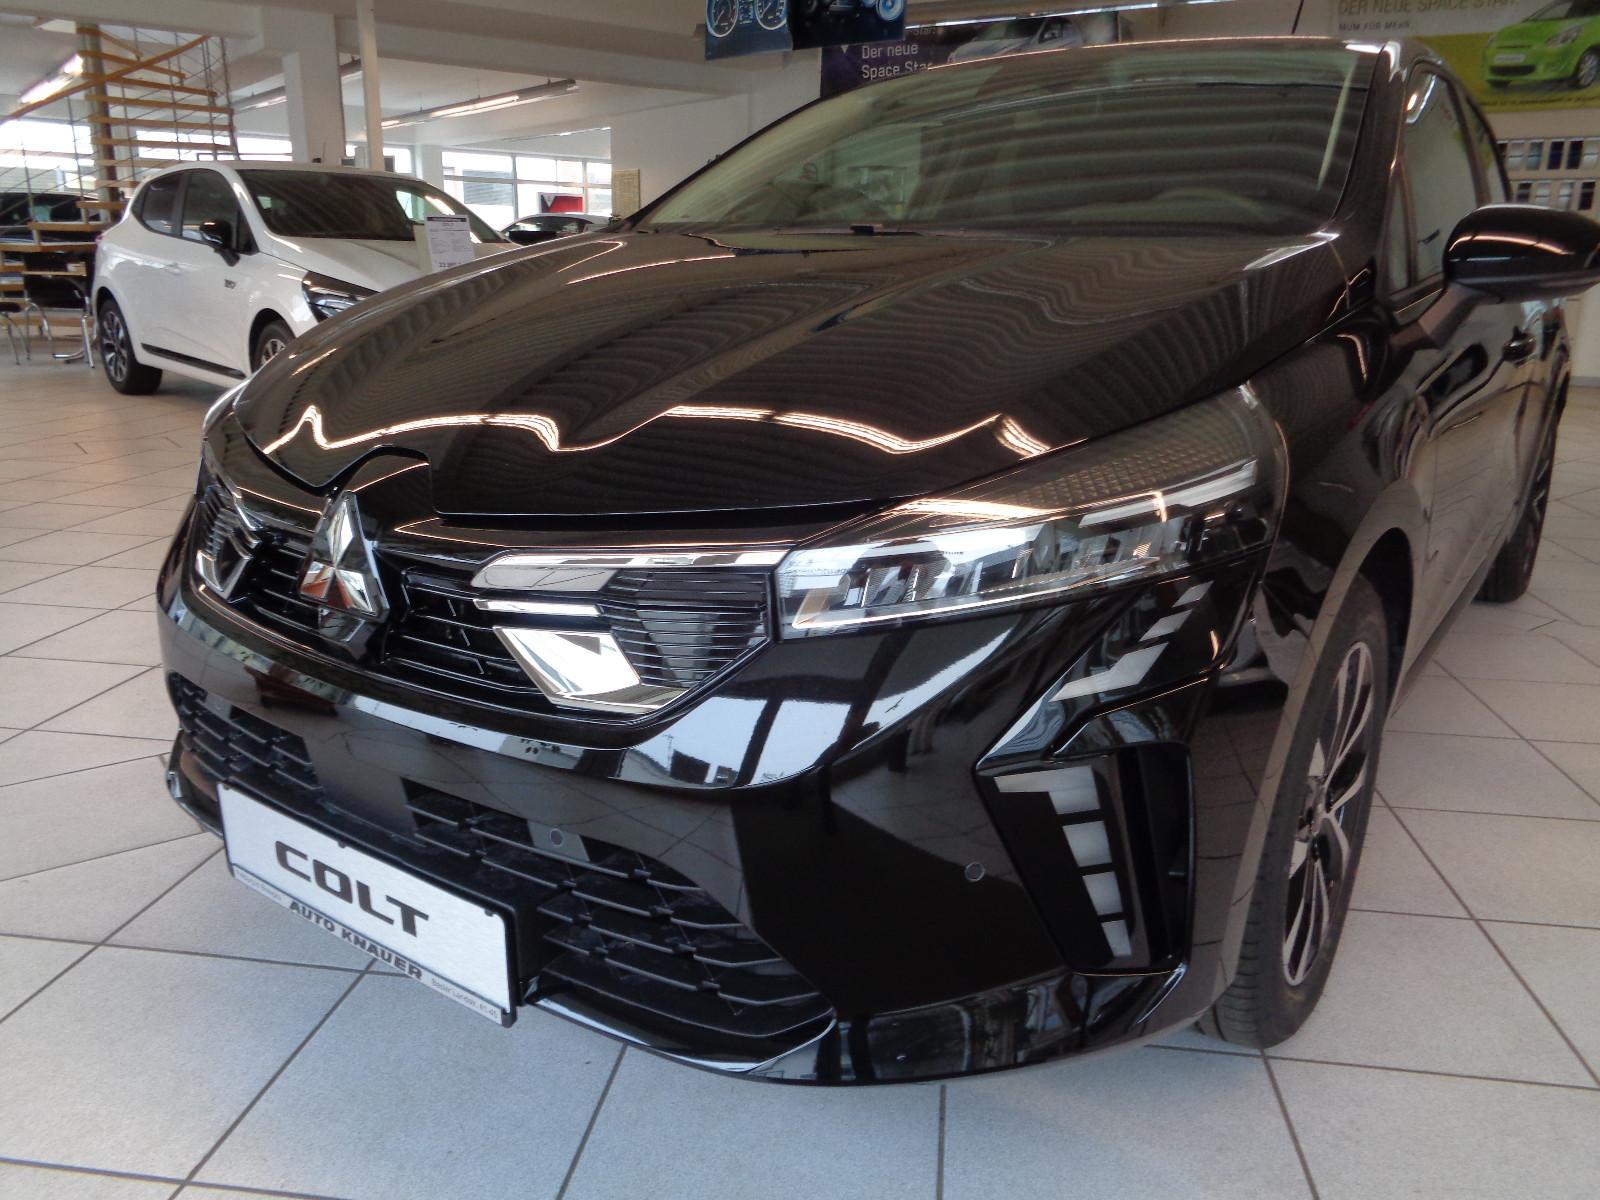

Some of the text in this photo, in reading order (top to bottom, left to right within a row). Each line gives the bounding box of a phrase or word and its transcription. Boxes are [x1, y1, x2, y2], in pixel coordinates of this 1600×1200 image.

[861, 43, 918, 59] Der neue
[861, 63, 900, 80] Space
[275, 840, 429, 938] COLT
[289, 901, 423, 980] AUTO KNAUER
